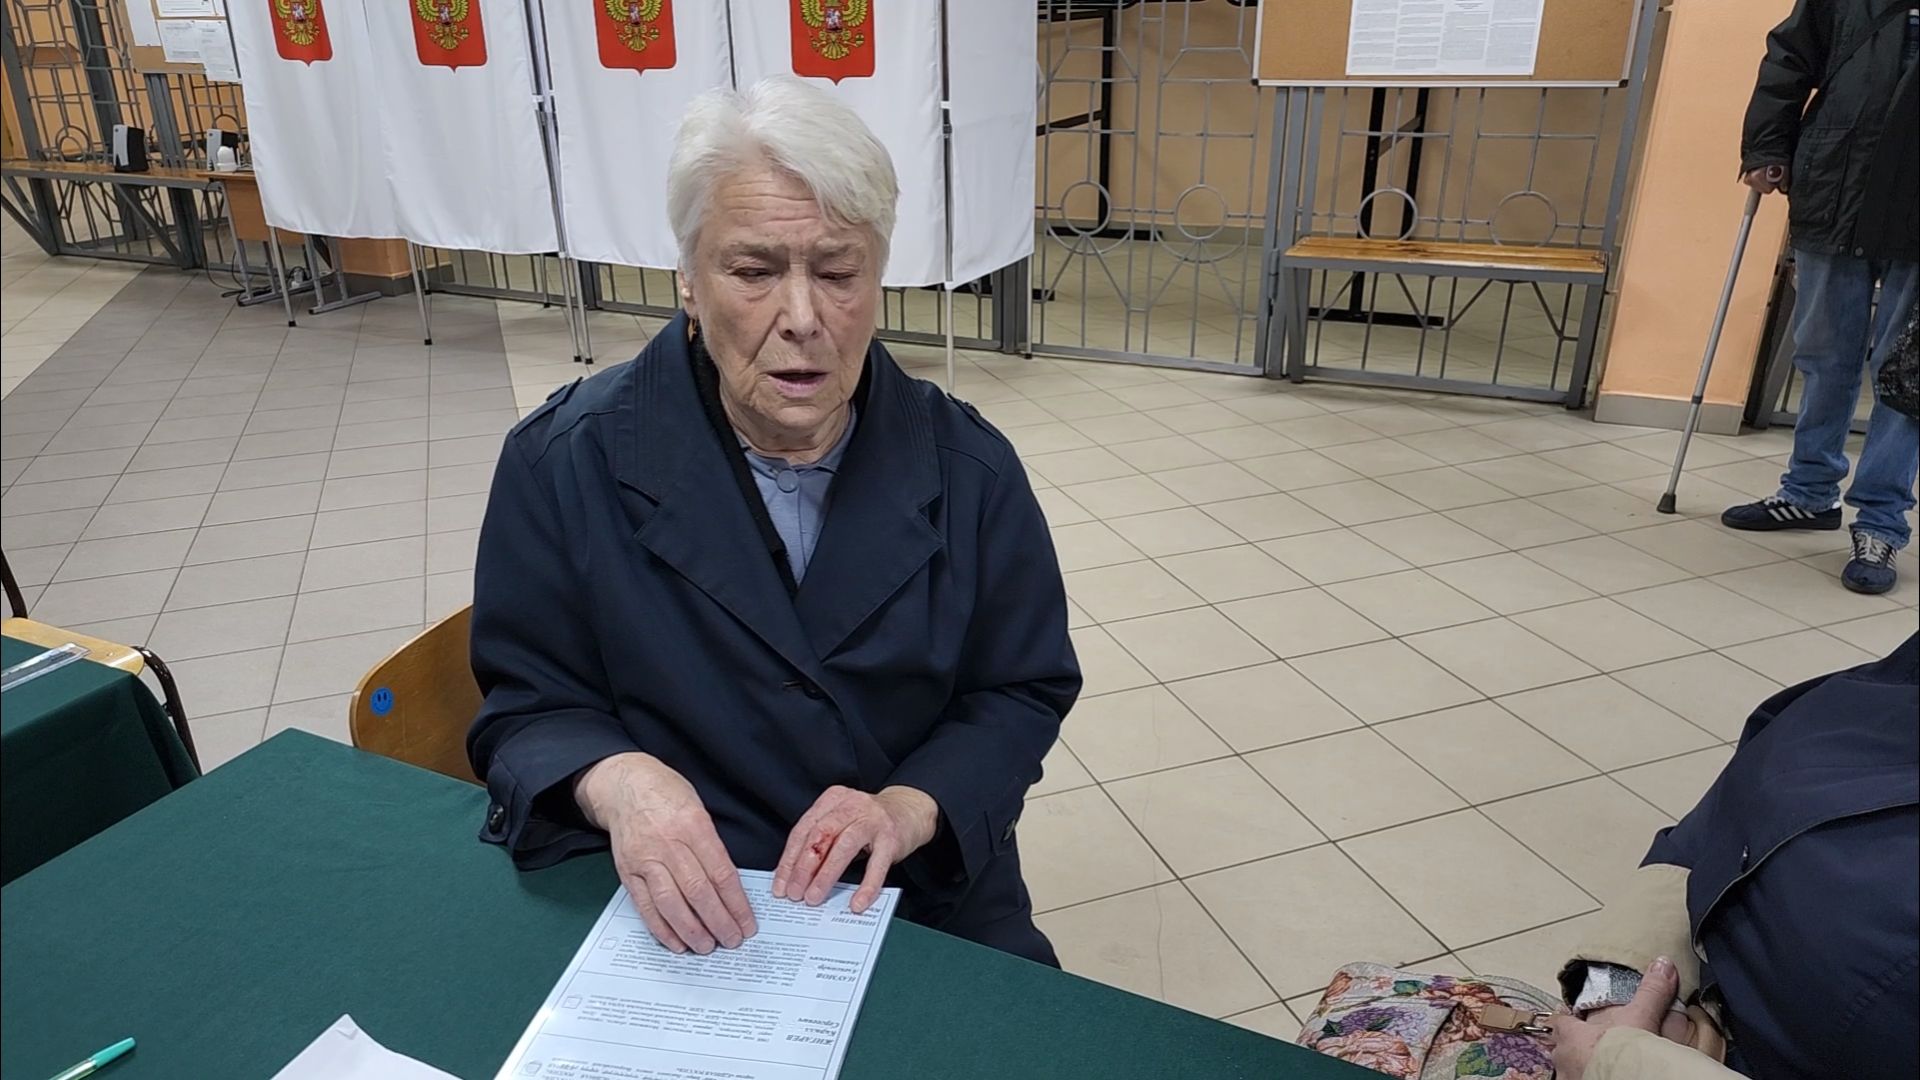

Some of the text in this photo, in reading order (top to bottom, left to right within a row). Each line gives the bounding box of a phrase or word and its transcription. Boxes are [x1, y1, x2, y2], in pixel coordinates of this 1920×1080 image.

[816, 973, 857, 982] НАУМОВ
[797, 1017, 840, 1028] Сергеевич
[804, 1027, 837, 1037] Кирилл
[785, 1034, 835, 1045] ЖИГАРЕВ
